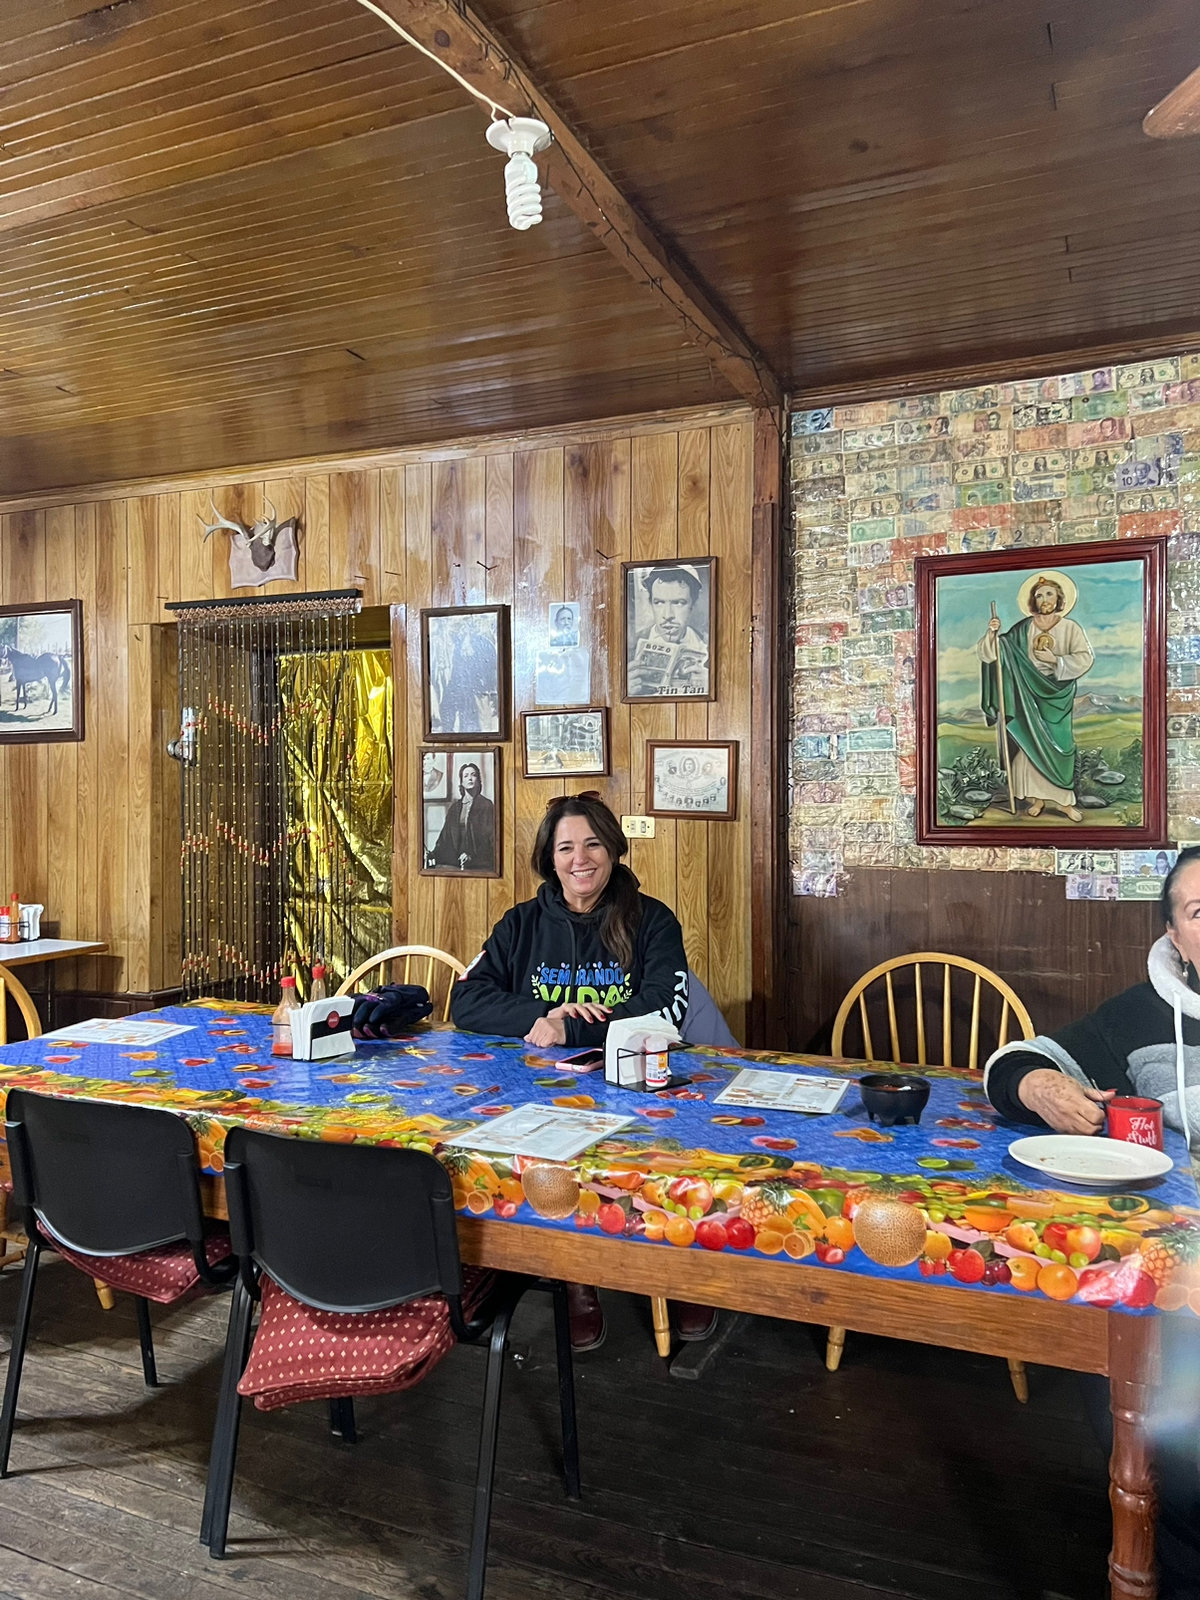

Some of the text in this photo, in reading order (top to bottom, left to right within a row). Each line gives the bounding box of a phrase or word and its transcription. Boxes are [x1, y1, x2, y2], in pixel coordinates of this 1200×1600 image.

[1122, 476, 1133, 486] 10
[1013, 529, 1022, 542] 2
[646, 644, 671, 653] BOZO
[658, 685, 705, 695] Tin Tan
[539, 967, 624, 985] SEMRANDO
[1129, 1117, 1154, 1130] Hot
[1126, 1130, 1157, 1146] Stuff
